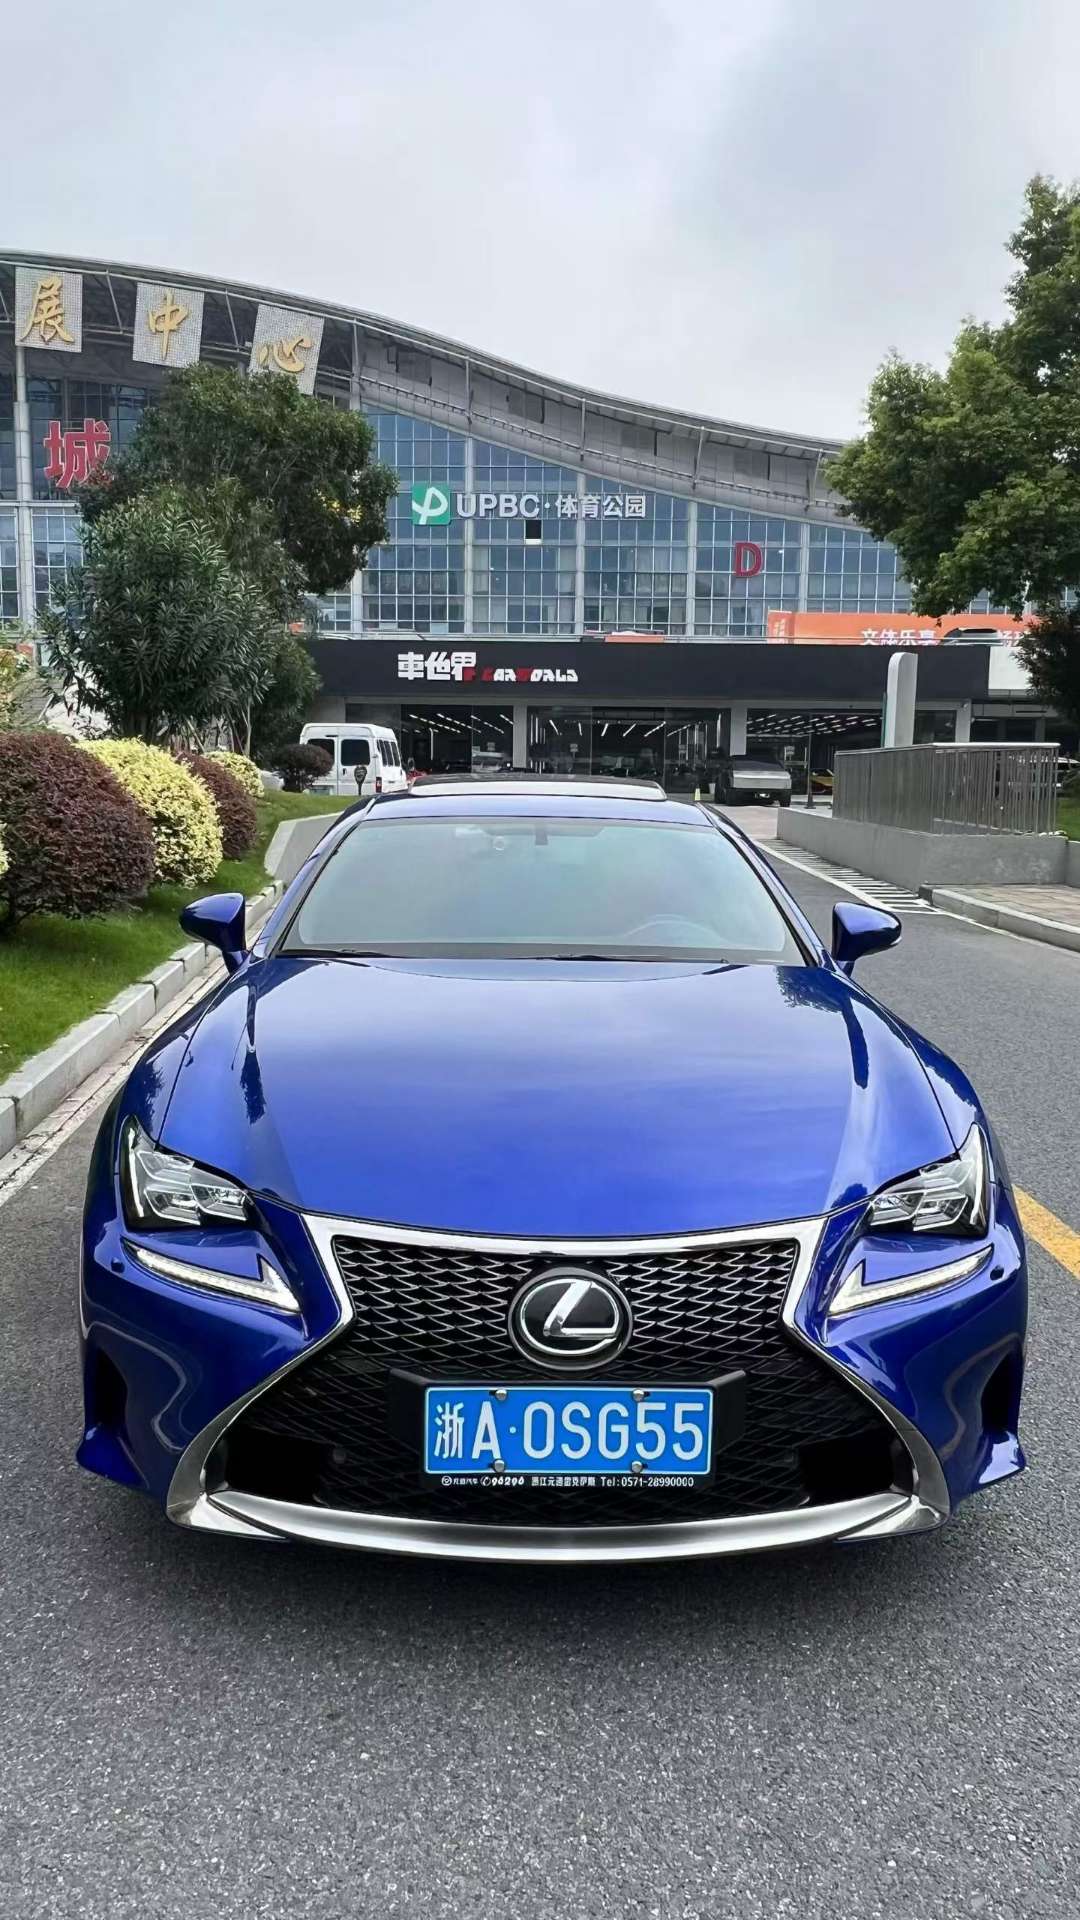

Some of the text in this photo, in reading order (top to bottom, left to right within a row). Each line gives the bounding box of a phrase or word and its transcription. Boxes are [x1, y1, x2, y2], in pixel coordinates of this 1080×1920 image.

[43, 417, 112, 490] 城
[735, 541, 763, 577] D
[491, 1476, 525, 1486] 96296
